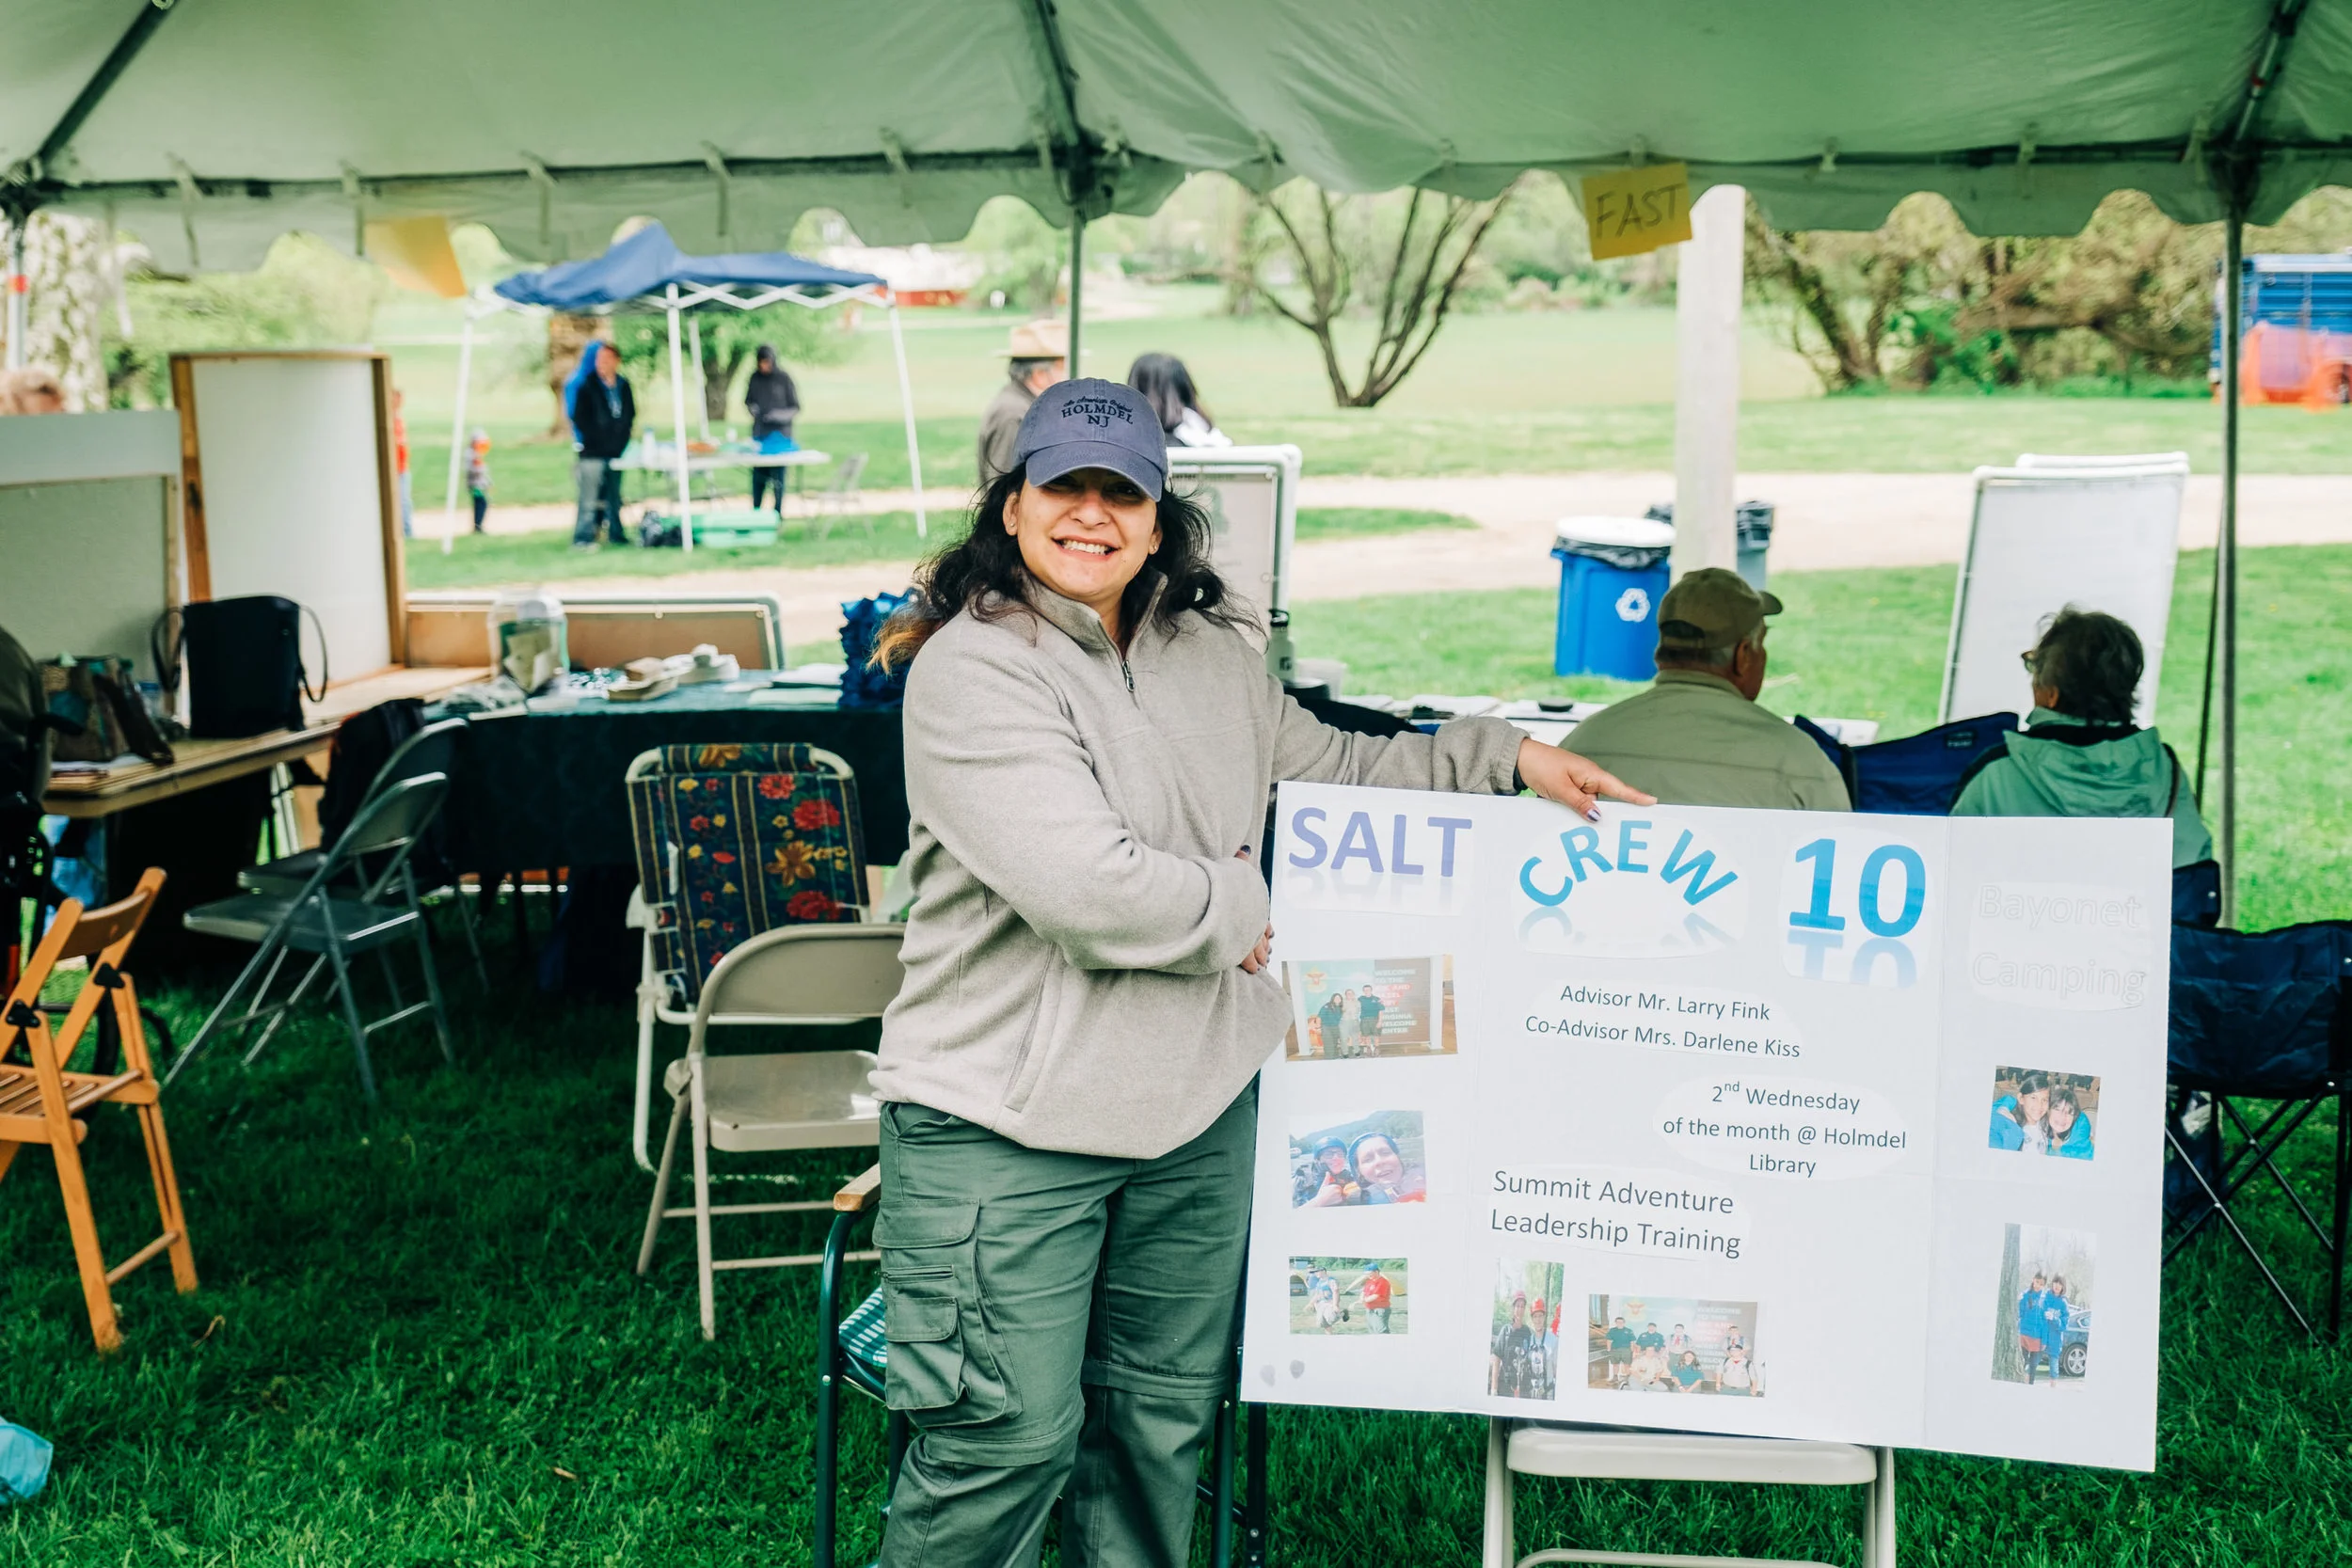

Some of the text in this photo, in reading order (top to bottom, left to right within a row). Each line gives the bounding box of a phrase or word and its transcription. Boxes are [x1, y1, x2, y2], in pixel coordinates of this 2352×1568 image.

[1597, 183, 1686, 238] FAST
[1061, 404, 1133, 425] HOLMDEL
[1087, 414, 1110, 427] NJ
[1289, 807, 1472, 877] SALT
[1519, 820, 1739, 906] CREW
[1789, 838, 1926, 937] 10
[1979, 885, 2141, 929] Bayonet
[1974, 952, 2146, 1006] Camping
[1560, 985, 1771, 1021] Advisor Mr. Larry Fink
[1525, 1015, 1801, 1058] Co-Advisor Mrs. Darlene Kiss
[1711, 1081, 1860, 1115] 2nd Wednesday
[1663, 1117, 1907, 1148] of the month @ Holmdel
[1749, 1153, 1817, 1179] Library
[1493, 1170, 1734, 1214] Summit Adventure
[1491, 1209, 1740, 1259] Leadership Training
